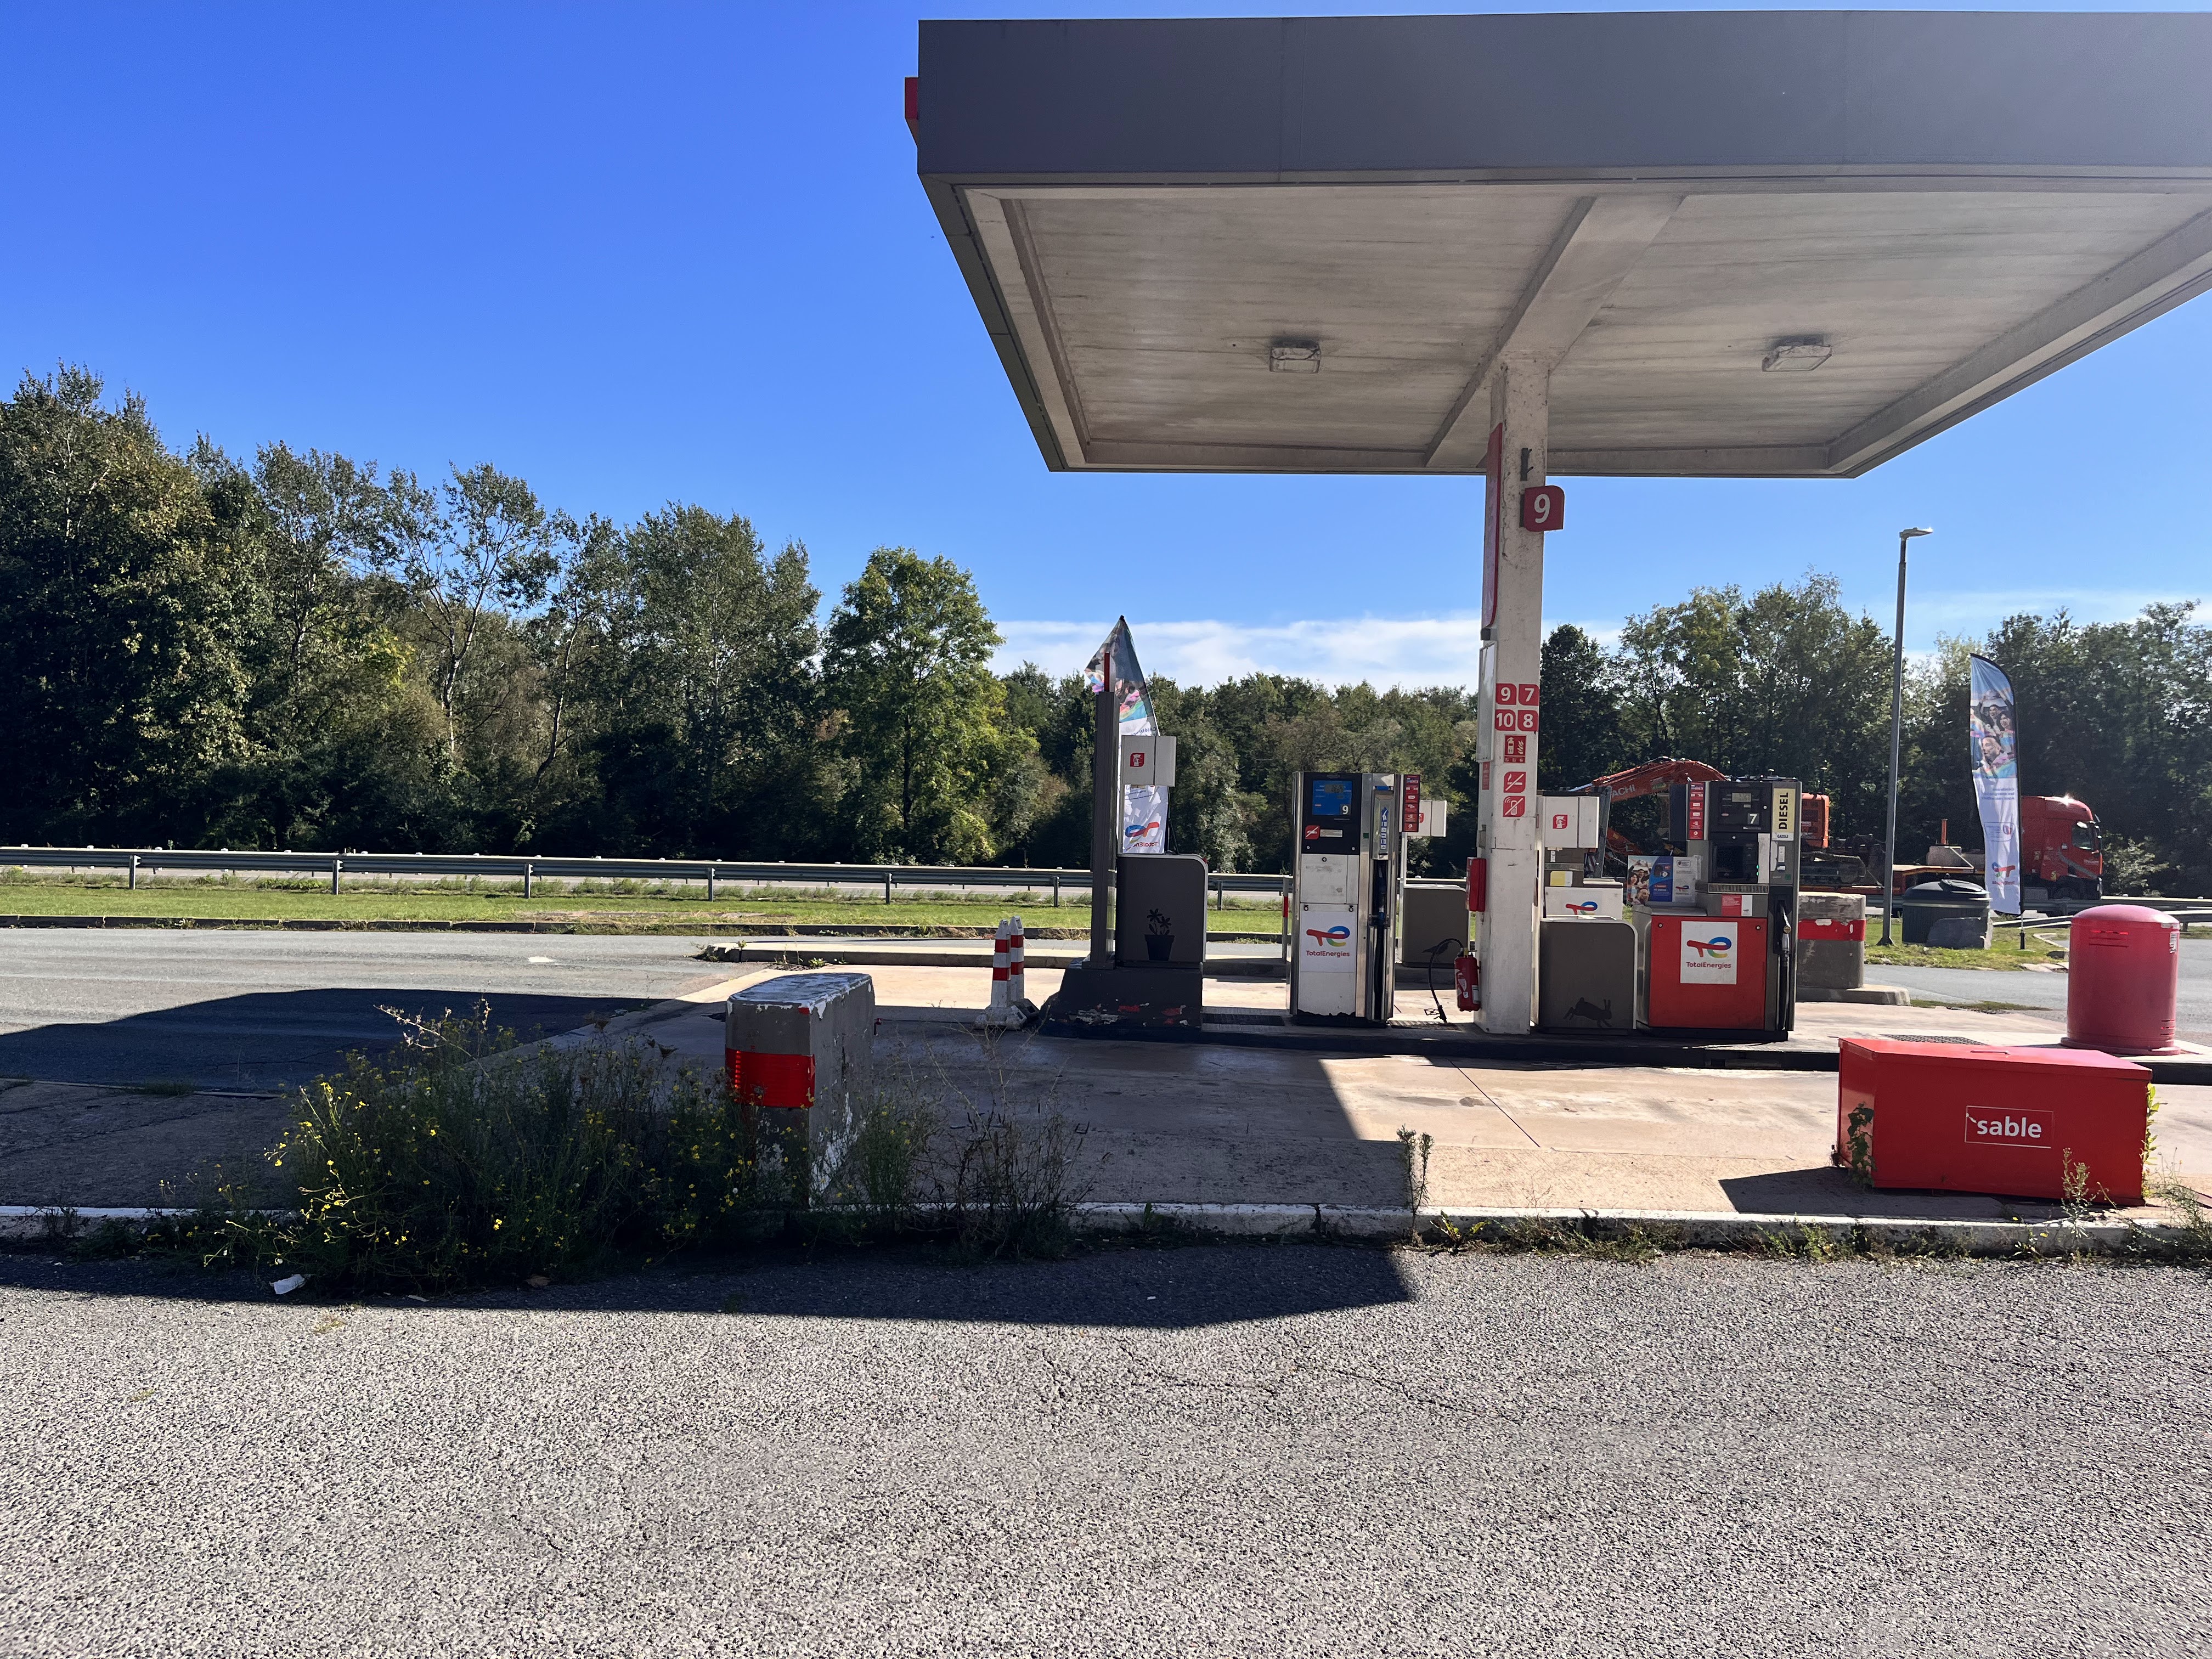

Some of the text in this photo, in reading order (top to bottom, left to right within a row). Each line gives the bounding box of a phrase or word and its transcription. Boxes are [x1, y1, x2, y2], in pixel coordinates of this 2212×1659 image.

[1534, 494, 1550, 523] 9
[1500, 687, 1535, 702] 9 7
[1496, 713, 1533, 728] 10 8
[1612, 785, 1635, 798] ACHI
[1342, 805, 1349, 815] 9
[1779, 792, 1788, 830] DIESEL
[1750, 814, 1757, 824] 7
[1686, 961, 1732, 969] TotalEnergies
[1976, 1116, 2042, 1138] sable
